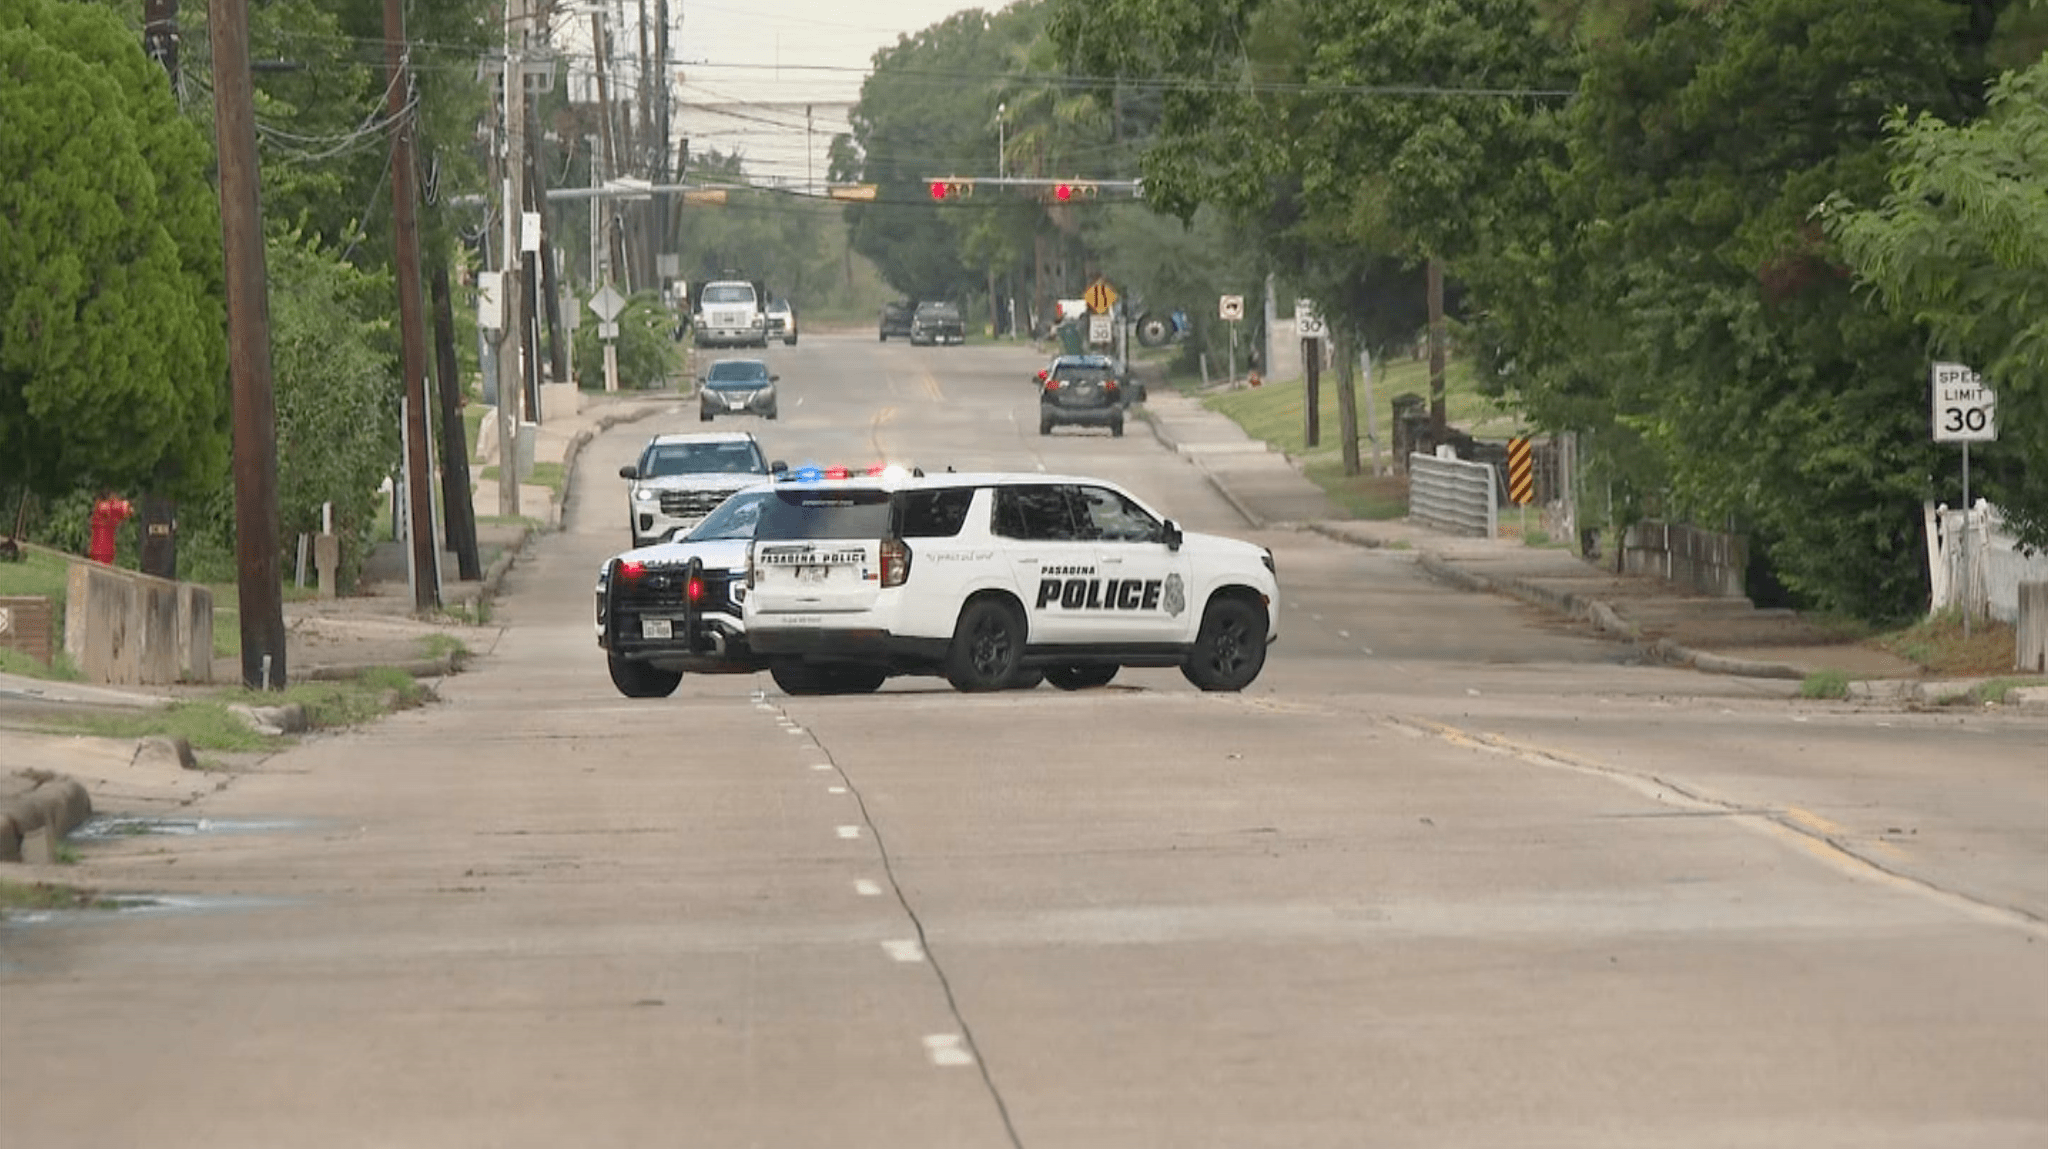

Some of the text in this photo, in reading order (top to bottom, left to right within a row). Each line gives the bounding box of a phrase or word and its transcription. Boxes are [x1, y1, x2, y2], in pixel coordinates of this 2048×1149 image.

[1300, 319, 1322, 333] 30
[1939, 371, 1981, 384] SPEE
[1944, 389, 1983, 401] LIMIT
[1945, 407, 1986, 433] 30
[822, 553, 866, 563] POLICE
[1041, 565, 1095, 575] PASADENA
[1034, 578, 1163, 610] POLICE
